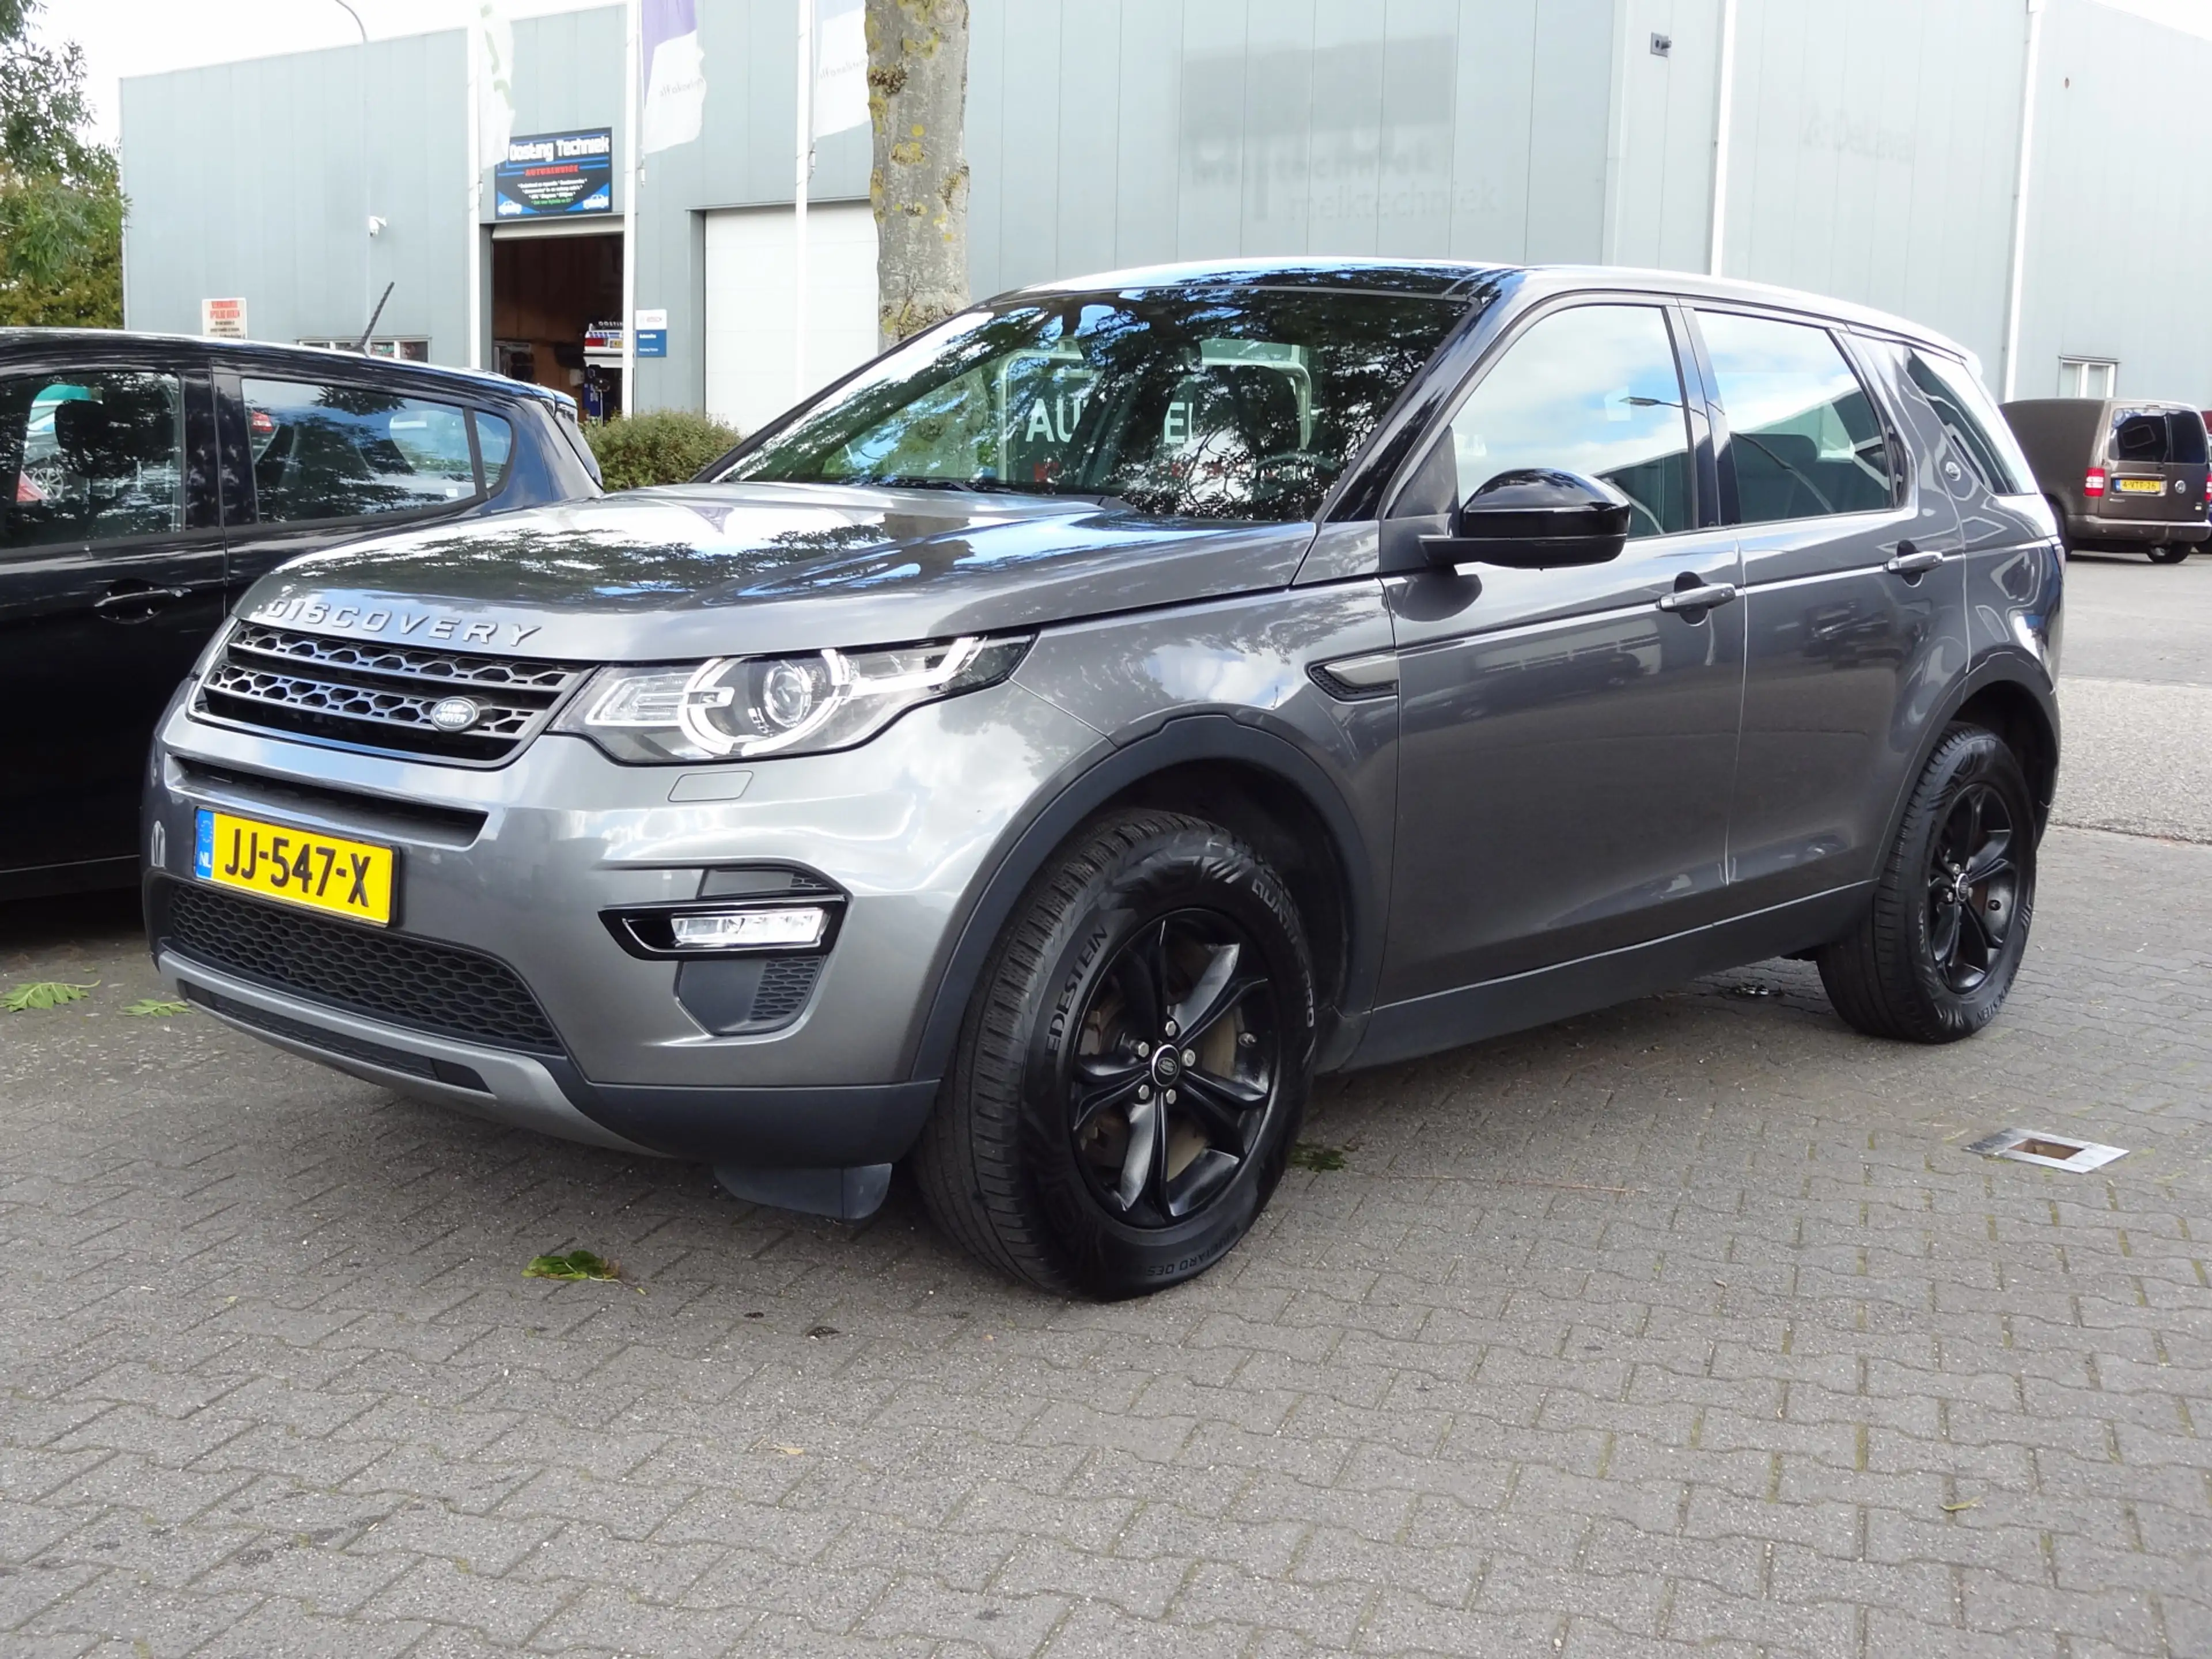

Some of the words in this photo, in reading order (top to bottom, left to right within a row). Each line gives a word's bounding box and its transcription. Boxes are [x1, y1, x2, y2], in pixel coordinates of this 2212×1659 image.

[266, 600, 541, 647] DISCOVERY
[199, 851, 212, 869] NL
[225, 828, 372, 907] JJ-547-X
